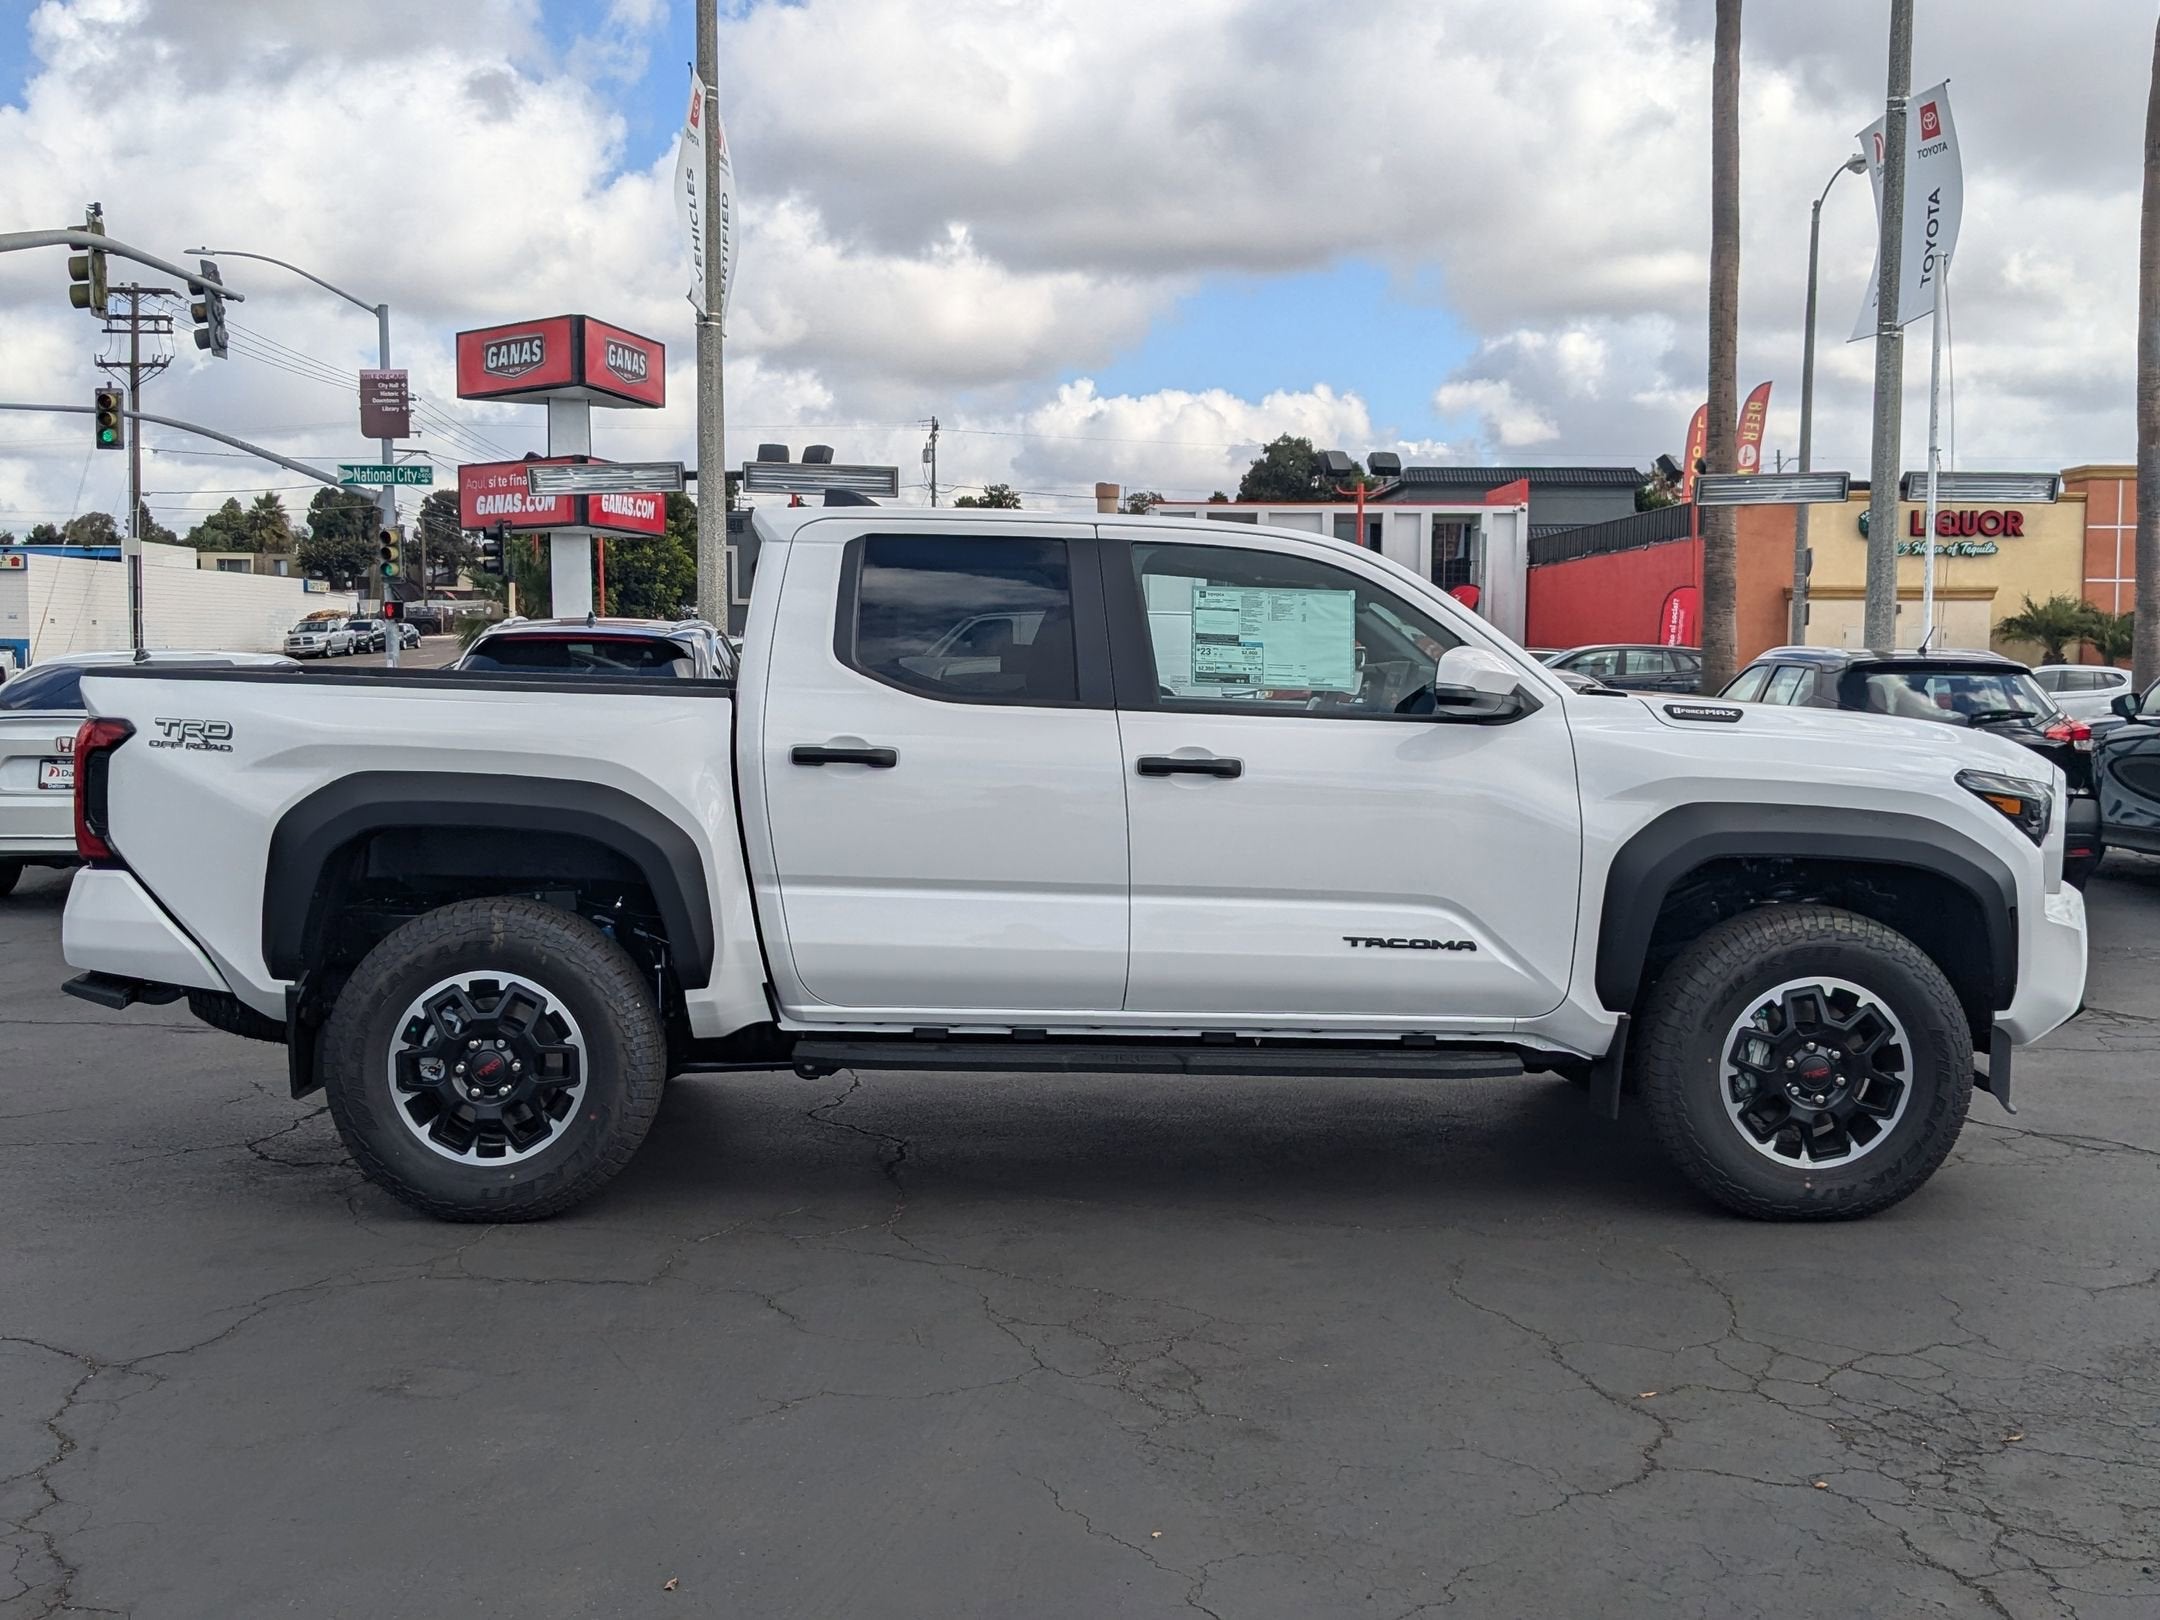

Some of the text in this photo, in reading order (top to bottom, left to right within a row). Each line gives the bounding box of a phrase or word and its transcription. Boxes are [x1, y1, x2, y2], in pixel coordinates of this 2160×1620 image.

[1916, 142, 1948, 160] TOYOTA
[686, 167, 703, 283] VEHICLES
[1919, 186, 1942, 289] TOYOTA
[720, 192, 729, 304] ERTIFIED
[487, 339, 542, 368] GANAS
[608, 344, 646, 376] GANAS
[1742, 402, 1763, 440] BEER
[353, 467, 395, 482] National
[397, 467, 418, 484] City
[498, 476, 508, 487] te
[476, 492, 556, 516] GANAS.COM
[601, 494, 656, 520] GANAS.COM
[1910, 509, 2024, 537] LQUOR
[1911, 540, 1944, 556] Hose
[1946, 542, 1958, 557] of
[1959, 541, 1997, 557] Tequila
[1200, 647, 1211, 656] 23
[154, 717, 233, 743] TRD
[148, 740, 233, 753] OFF ROAD
[1342, 936, 1477, 952] TACOMA
